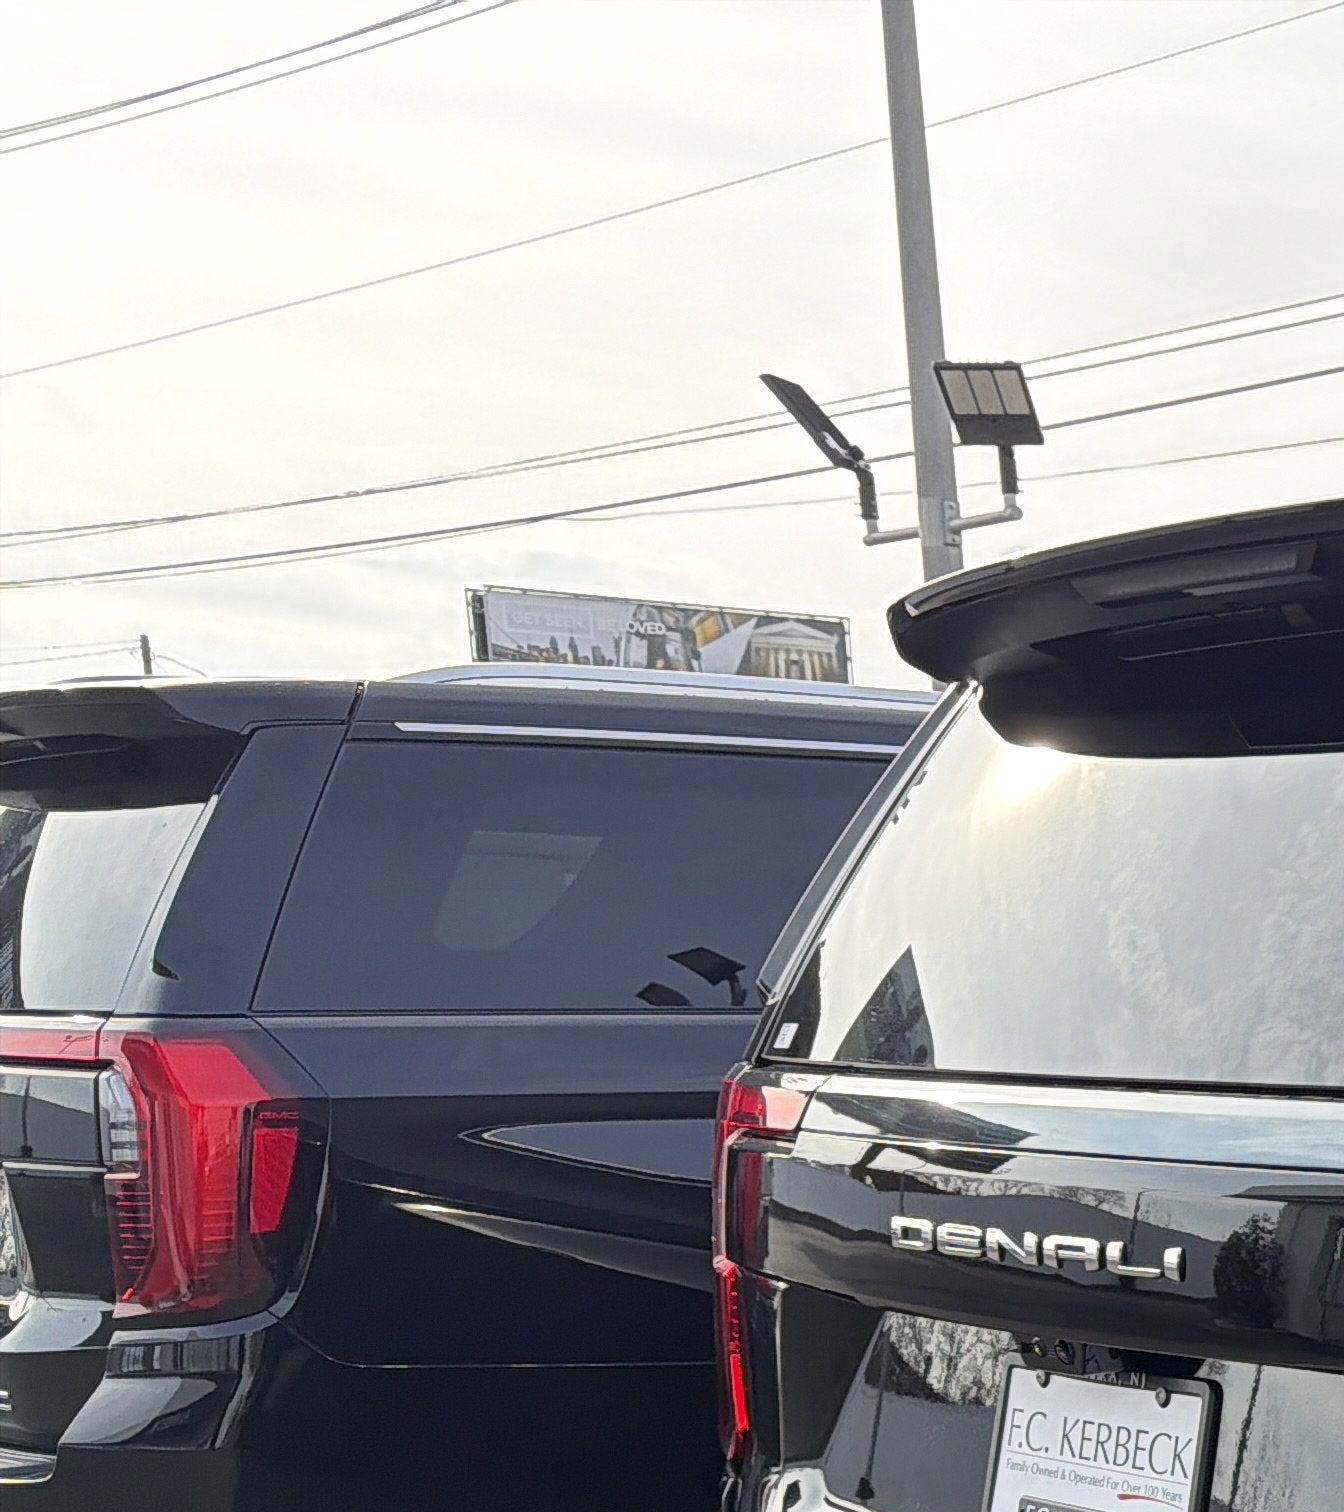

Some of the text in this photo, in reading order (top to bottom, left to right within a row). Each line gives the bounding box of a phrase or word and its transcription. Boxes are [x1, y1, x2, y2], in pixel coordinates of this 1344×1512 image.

[890, 1214, 1187, 1283] DENALI
[1007, 1407, 1193, 1479] F.C. KERBECK
[1006, 1457, 1183, 1503] Family Owned & Operated For Over 100 Years
